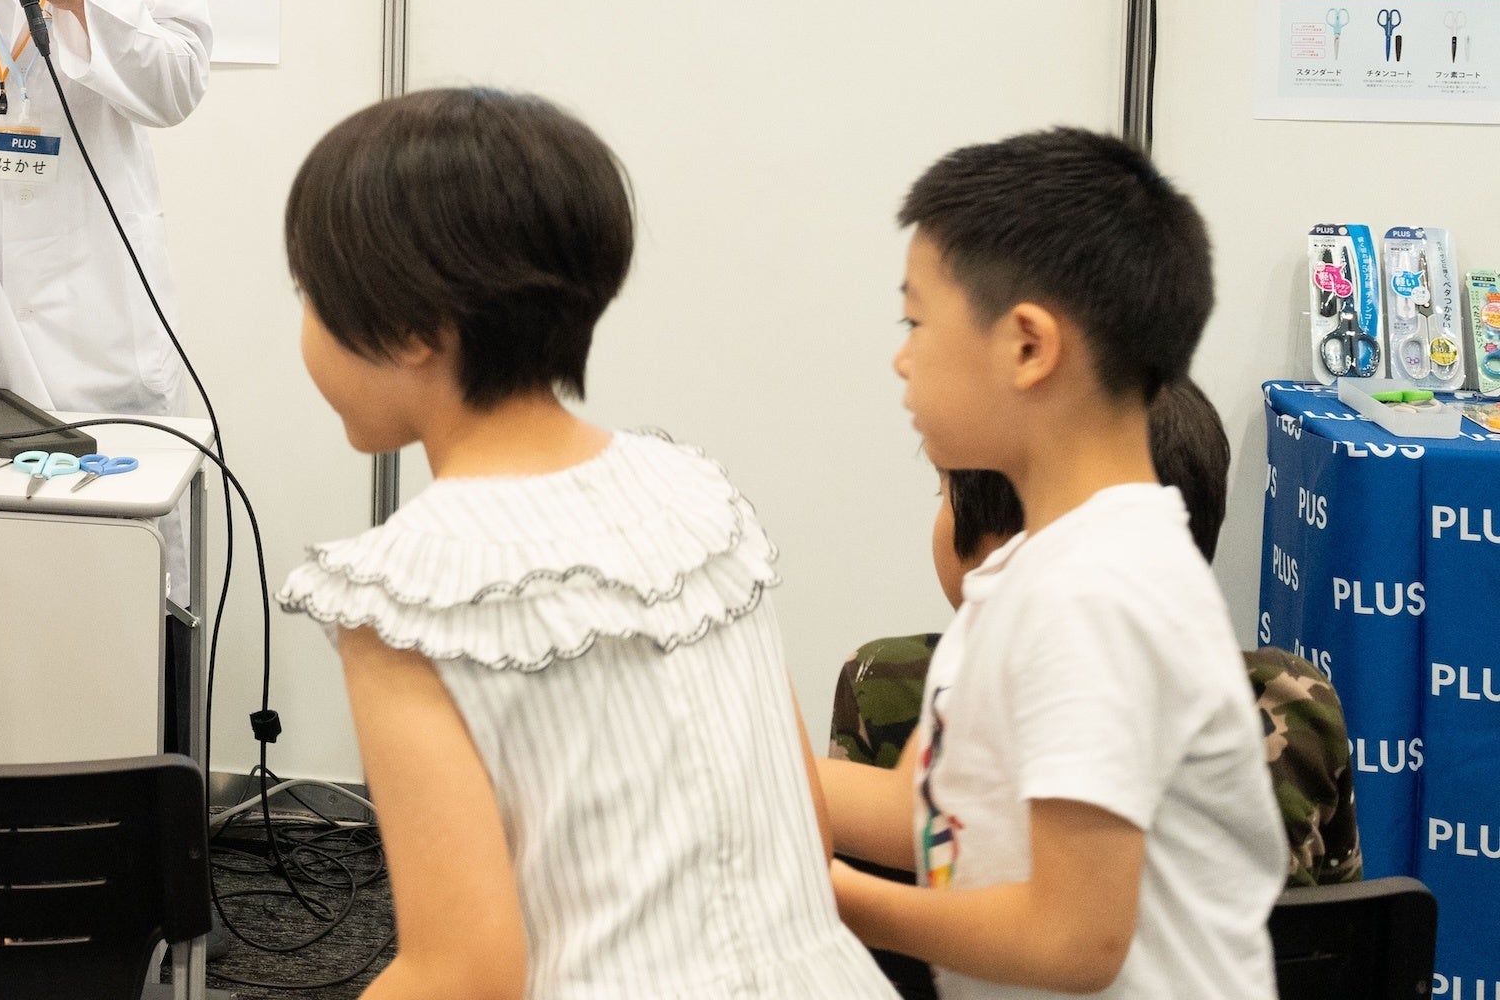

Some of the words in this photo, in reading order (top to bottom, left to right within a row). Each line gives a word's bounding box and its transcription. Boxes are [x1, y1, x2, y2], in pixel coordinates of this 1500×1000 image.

[1296, 68, 1343, 77] スタンダード
[1366, 70, 1413, 78] チタンコート
[12, 138, 37, 149] PLUS
[1392, 230, 1411, 238] PLUS
[1273, 544, 1299, 591] PLUS
[1333, 576, 1426, 616] PLUS
